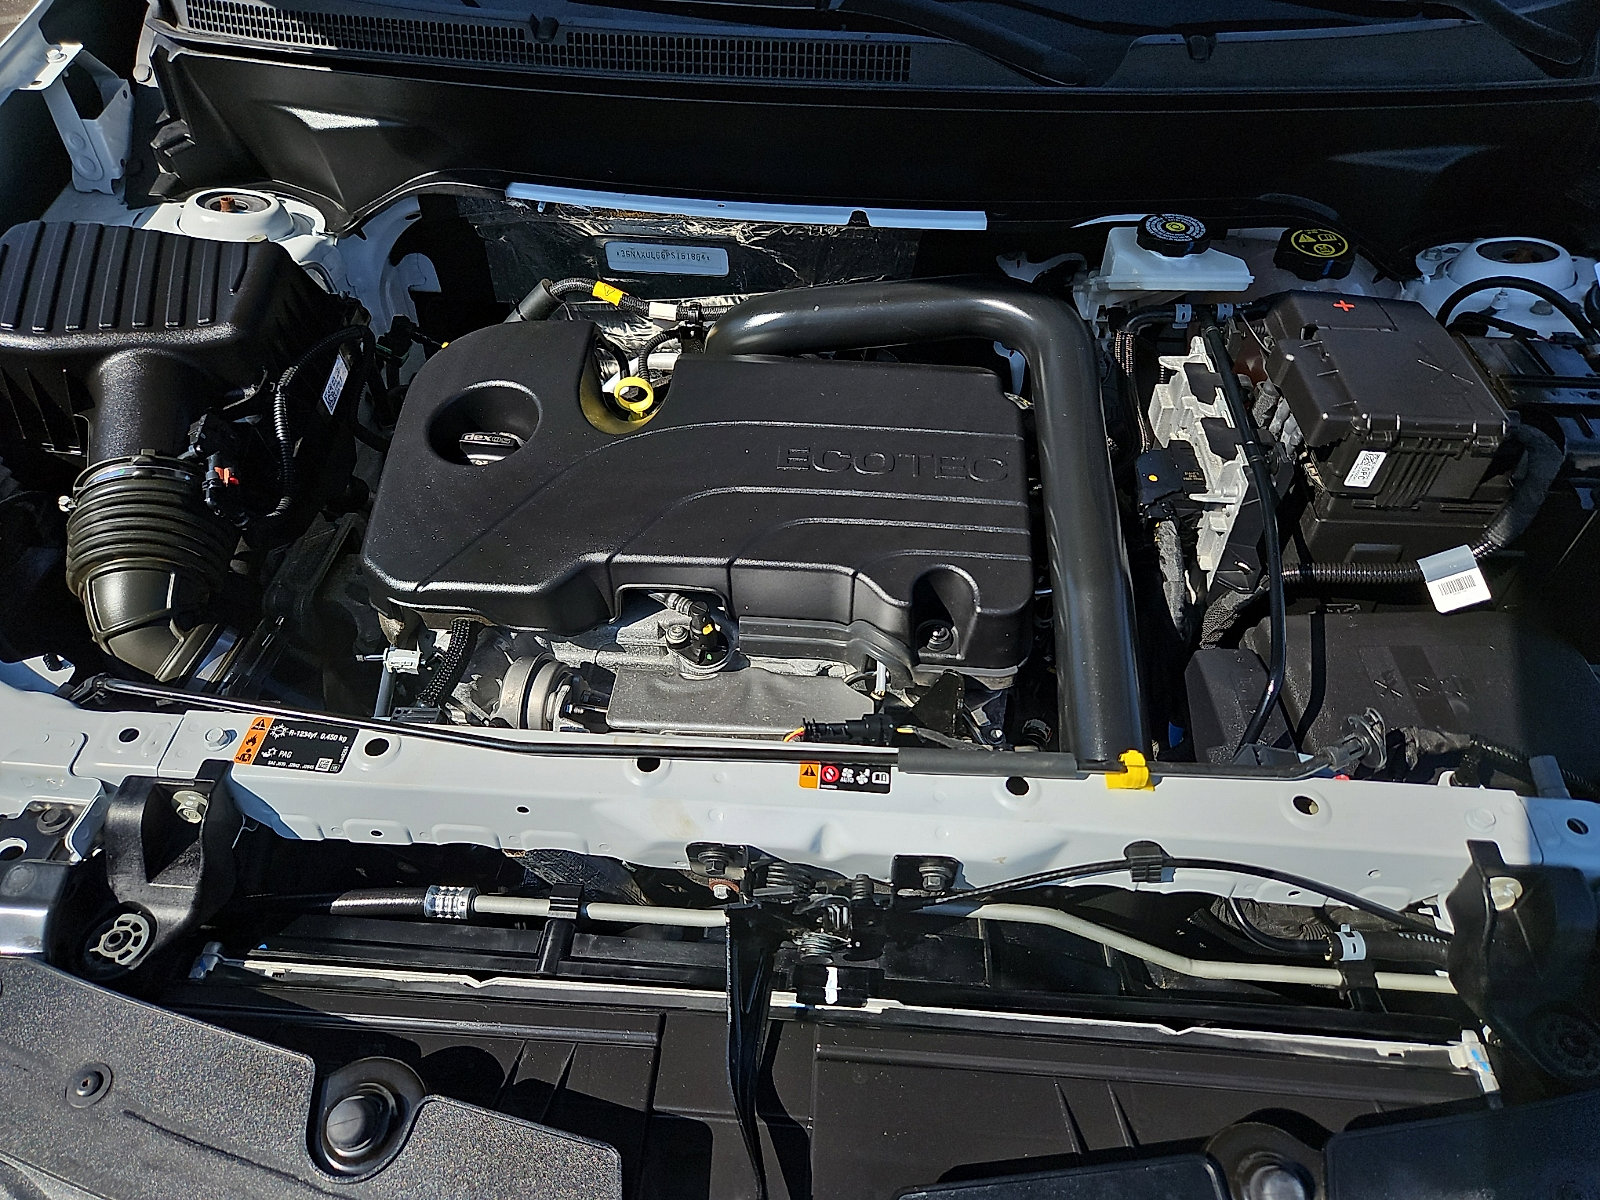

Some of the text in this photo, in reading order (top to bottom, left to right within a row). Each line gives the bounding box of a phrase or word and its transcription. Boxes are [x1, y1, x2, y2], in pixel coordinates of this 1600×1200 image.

[464, 433, 511, 445] dexos
[776, 447, 1009, 483] ECOTEC
[288, 729, 318, 740] R-1234yf
[338, 734, 348, 743] kg
[278, 750, 293, 759] PAG
